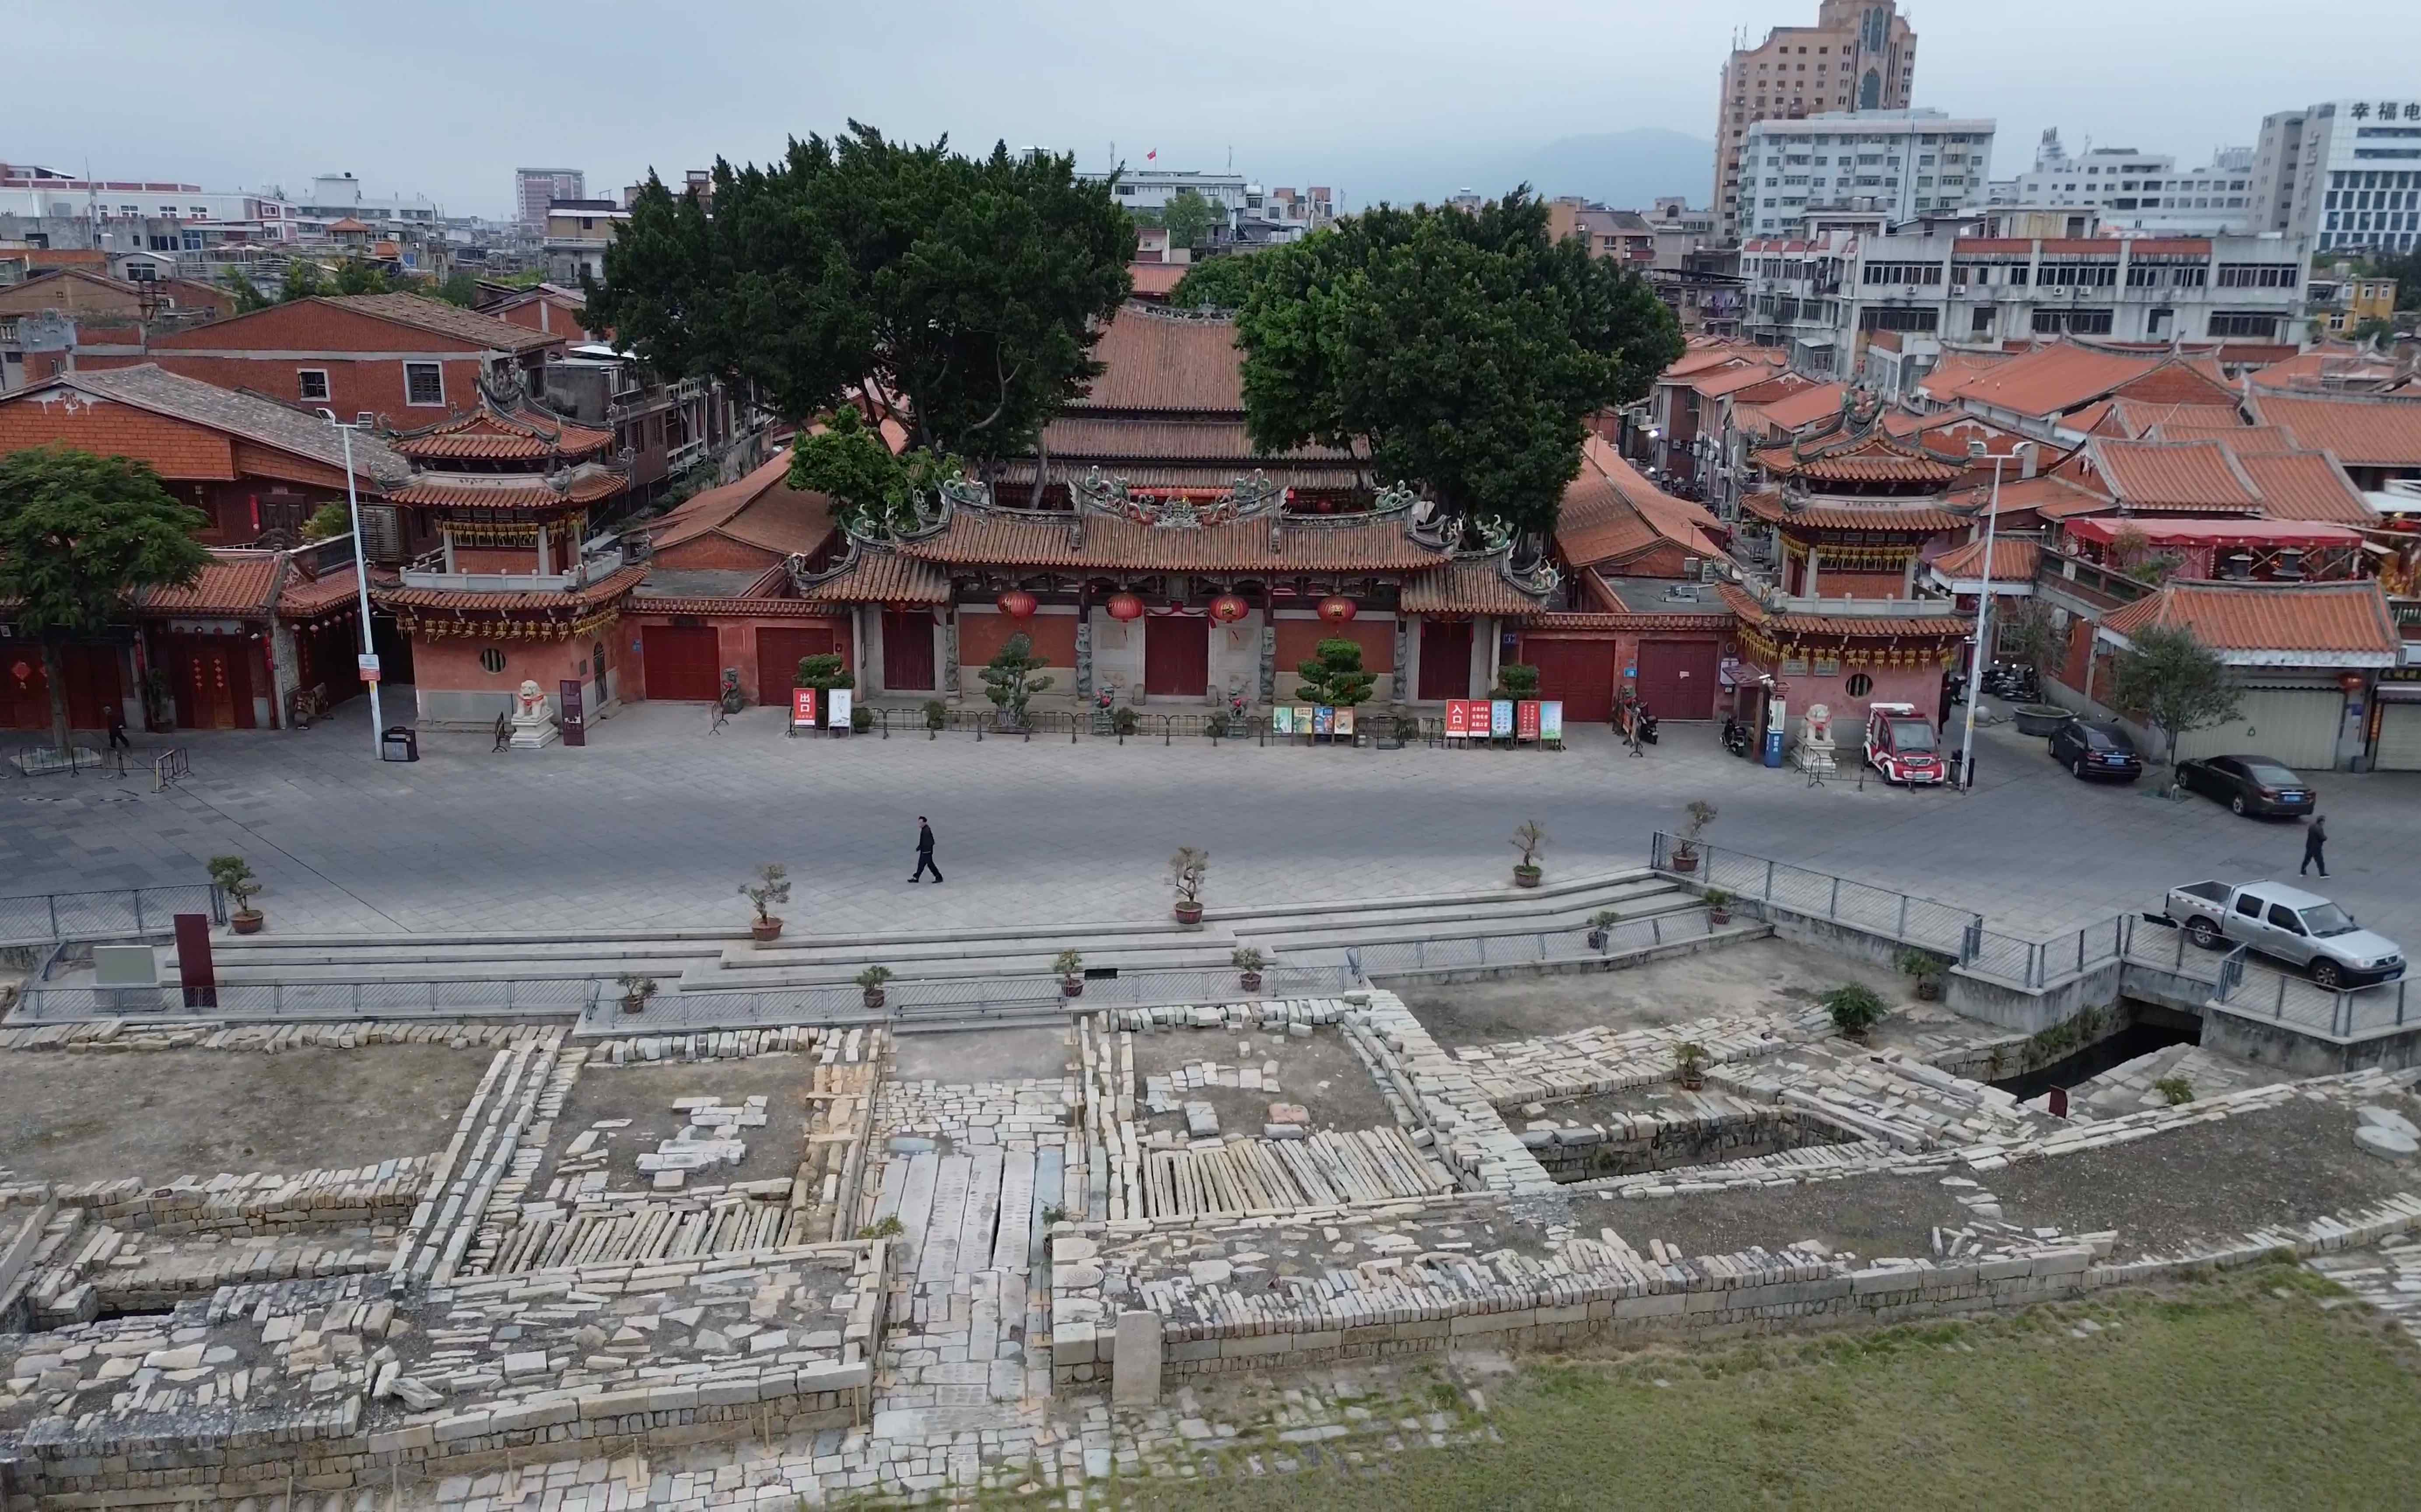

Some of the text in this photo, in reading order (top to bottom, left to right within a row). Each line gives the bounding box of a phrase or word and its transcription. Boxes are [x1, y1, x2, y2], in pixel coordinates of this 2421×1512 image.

[2351, 102, 2421, 121] 幸福电
[800, 693, 809, 712] 出口
[1452, 705, 1463, 724] 入口
